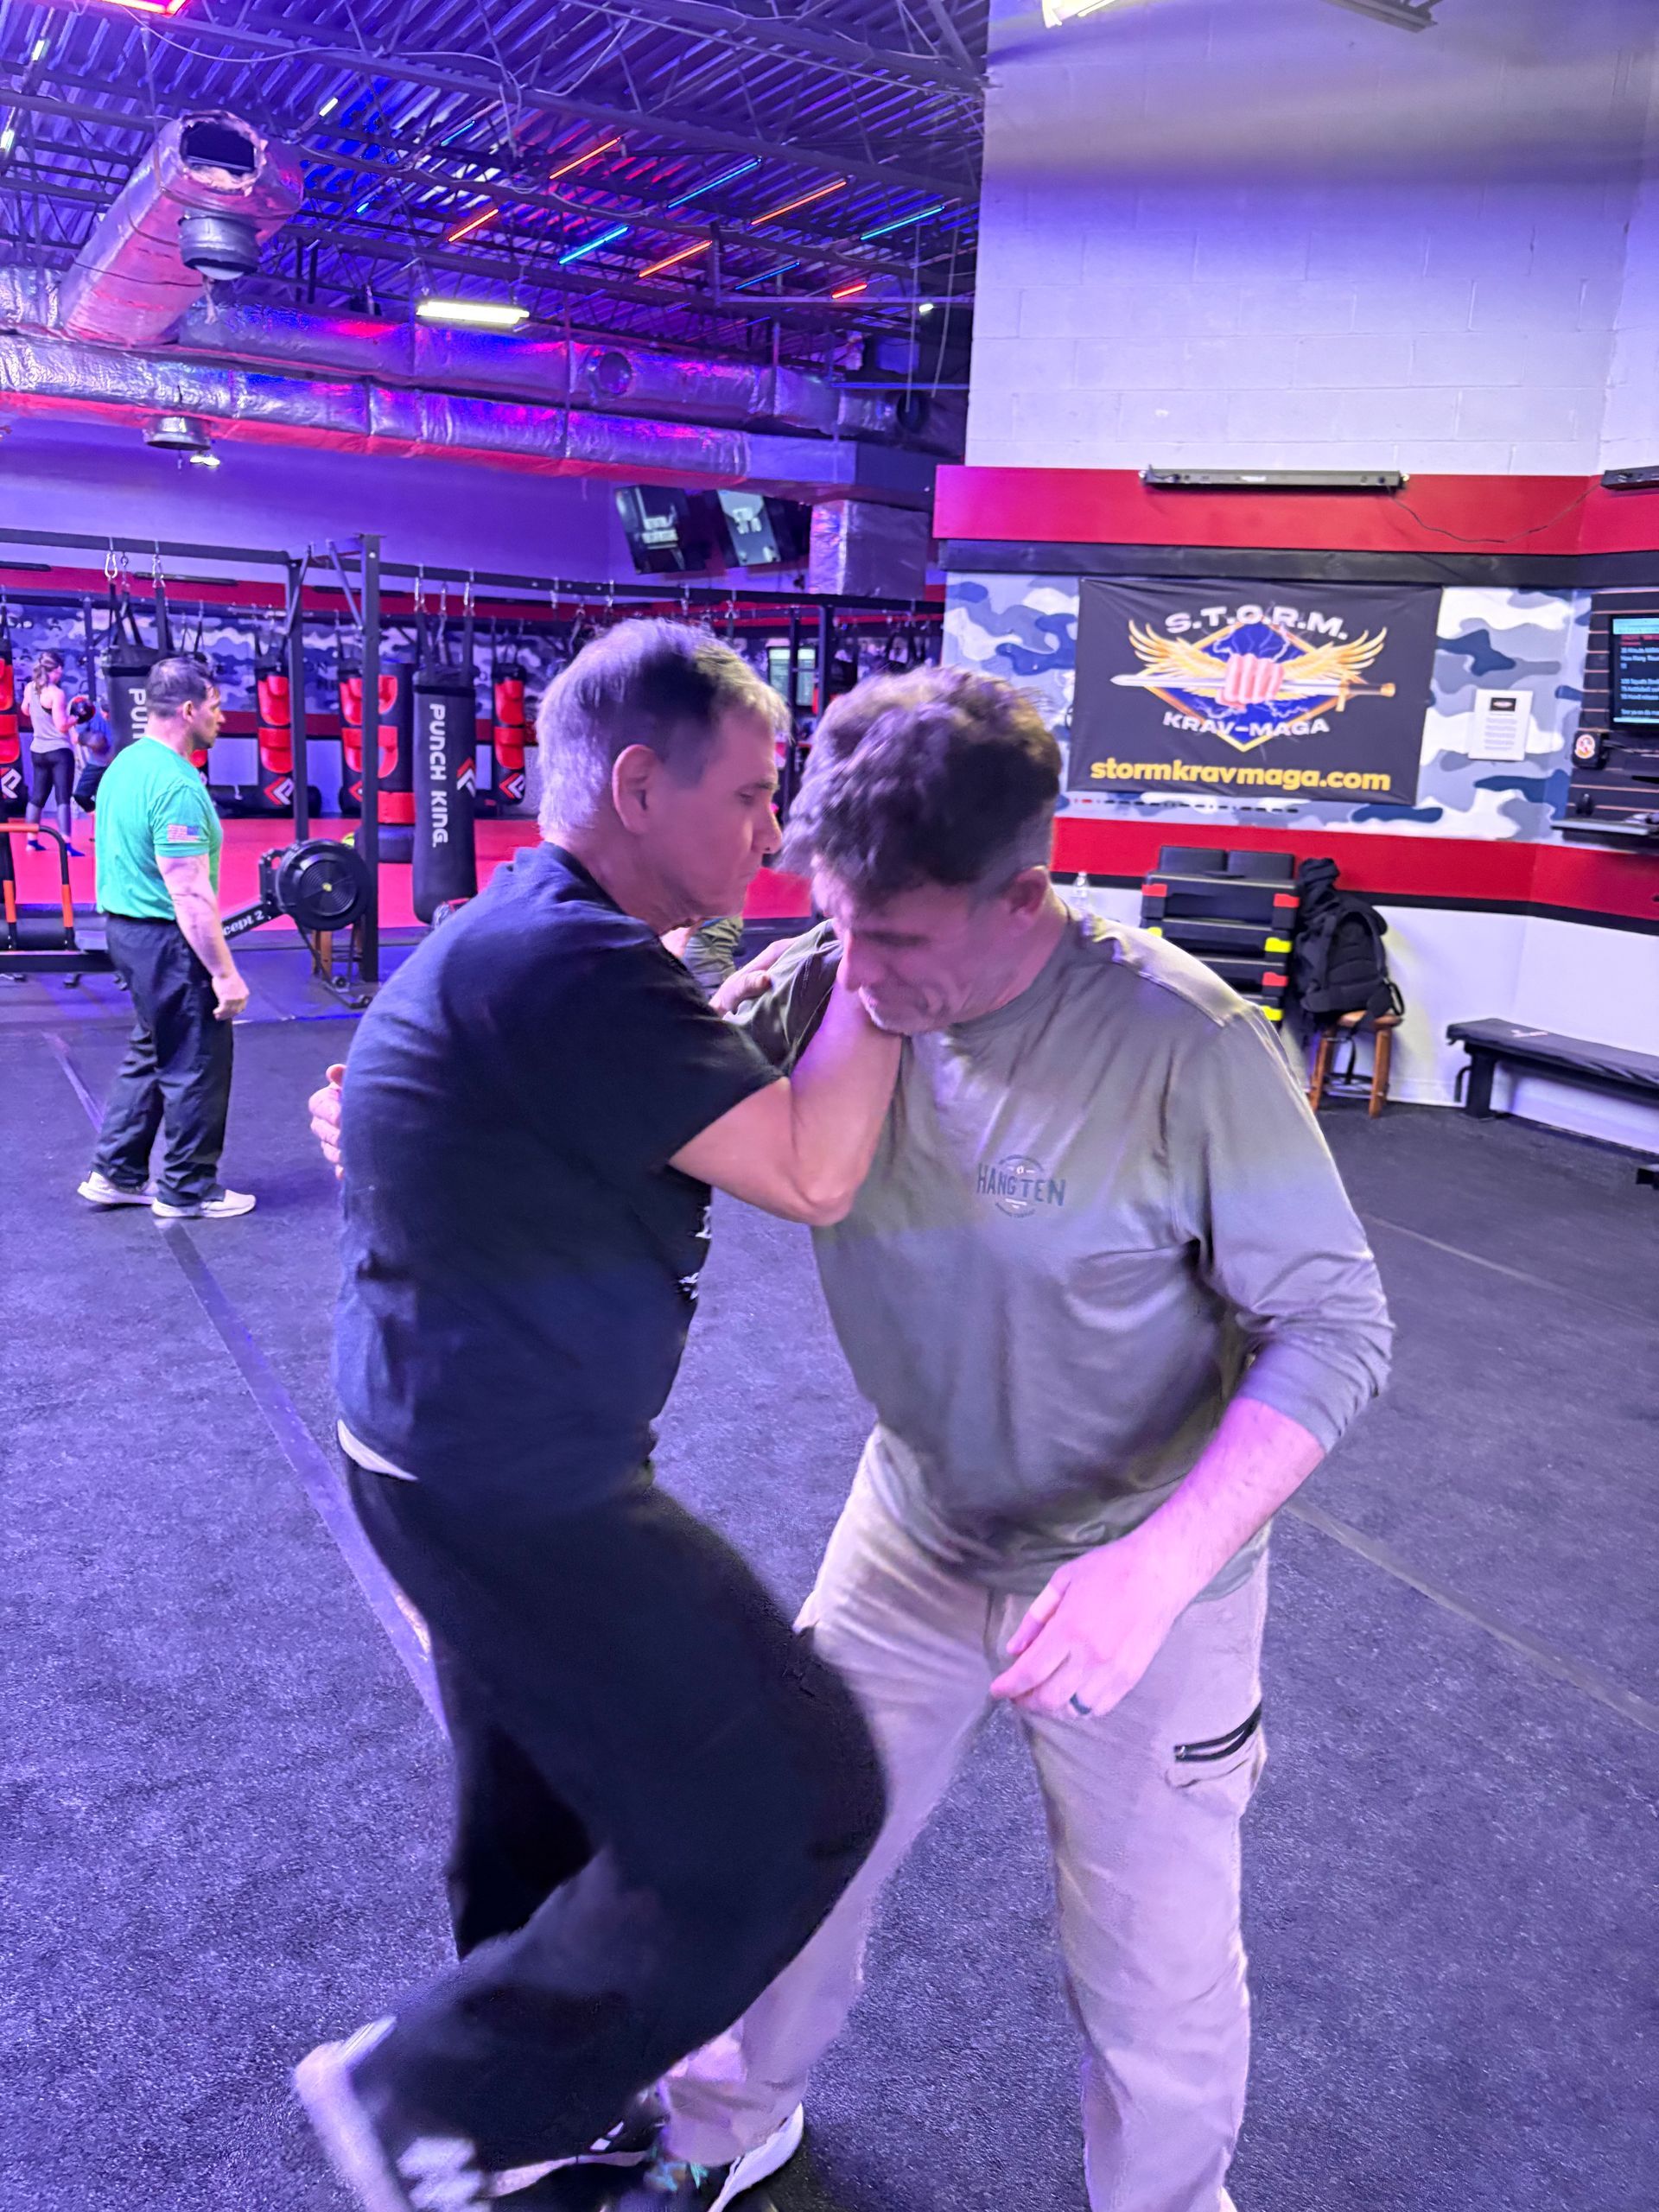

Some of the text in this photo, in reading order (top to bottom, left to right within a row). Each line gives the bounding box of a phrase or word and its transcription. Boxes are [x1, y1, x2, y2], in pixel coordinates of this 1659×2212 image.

[1165, 604, 1349, 640] S.T.O.R.M.
[128, 688, 149, 740] PUN
[429, 702, 448, 781] PUNCH
[1090, 757, 1391, 791] stormkravmaga.com
[222, 915, 254, 936] cept
[976, 1163, 1066, 1206] HANG TEN
